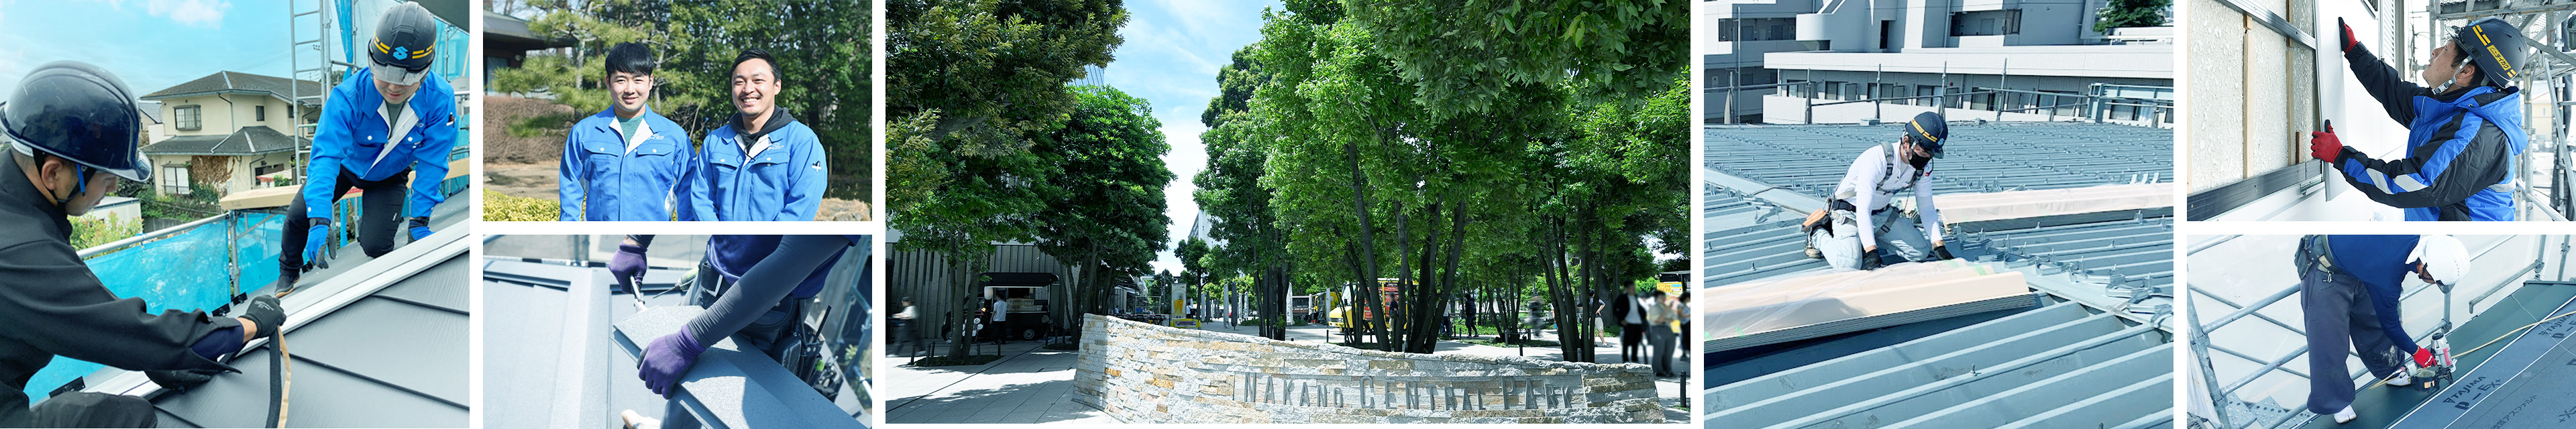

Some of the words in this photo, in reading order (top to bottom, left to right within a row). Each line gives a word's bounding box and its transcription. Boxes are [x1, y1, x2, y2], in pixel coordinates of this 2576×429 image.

[1244, 372, 1343, 408] NAKANO
[1360, 375, 1486, 410] CENTRAL
[1501, 375, 1574, 410] PARK
[2451, 376, 2486, 399] TAJIMA
